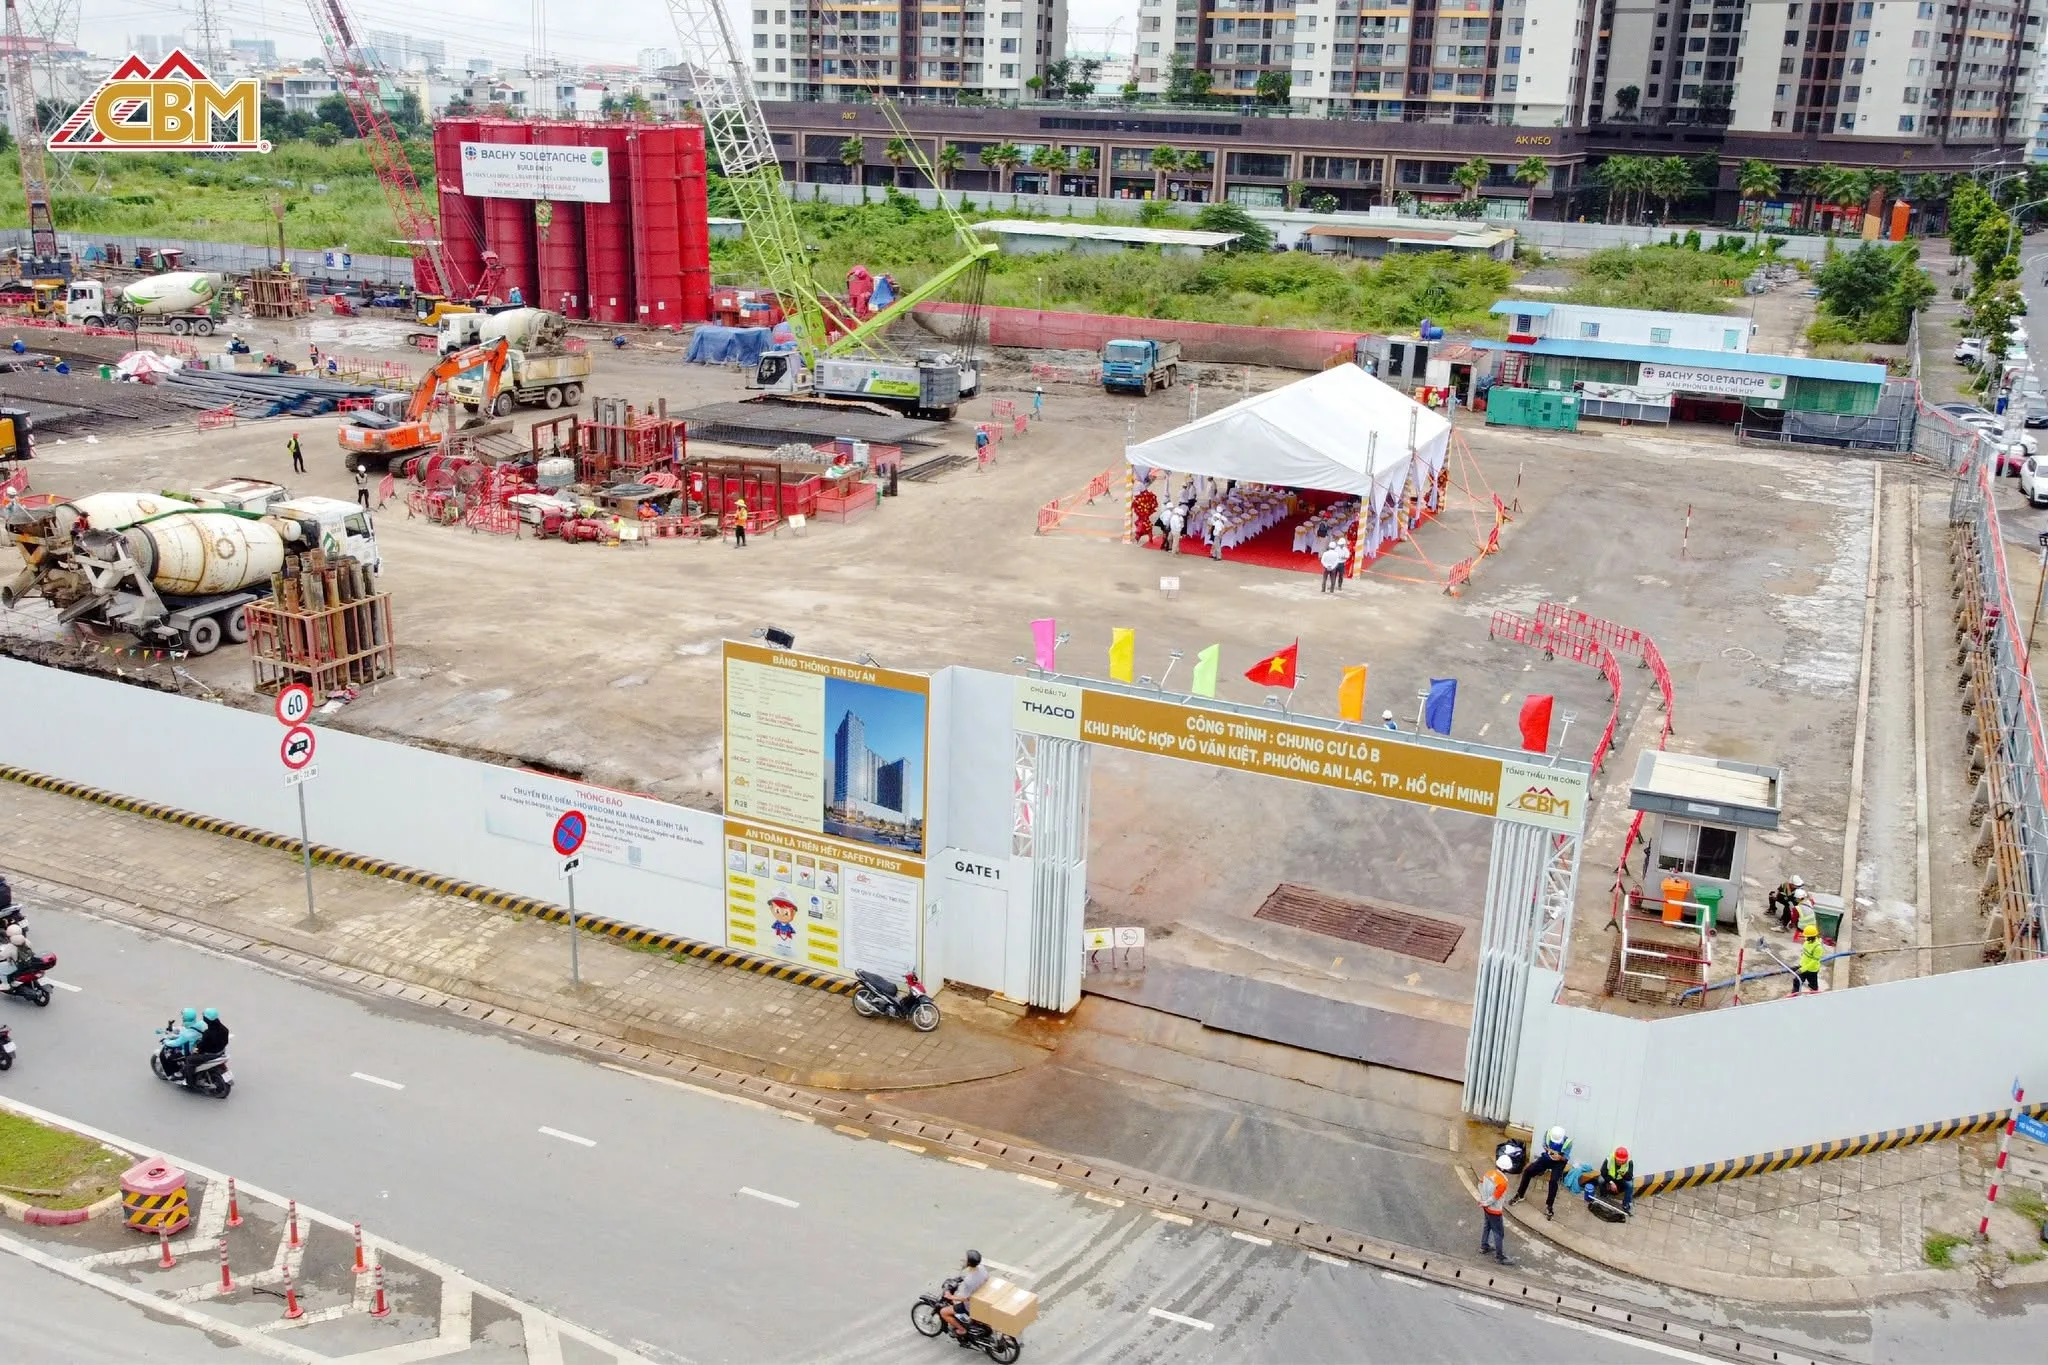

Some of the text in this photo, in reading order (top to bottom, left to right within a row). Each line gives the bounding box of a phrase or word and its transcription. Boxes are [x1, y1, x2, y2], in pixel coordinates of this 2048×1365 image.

[1515, 136, 1552, 145] AK NEO
[481, 150, 516, 160] BACHY
[1658, 370, 1693, 380] BACHY
[832, 666, 846, 676] TIN
[288, 694, 303, 715] 60
[1022, 700, 1075, 719] THACO
[1186, 714, 1224, 734] CÔNG
[1227, 722, 1267, 744] TRÌNH
[1277, 732, 1324, 753] CHUNG
[1327, 740, 1348, 757] CƯ
[1349, 743, 1368, 760] LÔ
[1371, 748, 1380, 763] B
[1084, 720, 1495, 806] KHU PHỨC HỢP VÕ VĂN KIỆT, PHƯỜNG AN LẠC, TP. HỒ CHÍ MINH
[1548, 774, 1558, 782] THI
[1560, 776, 1581, 786] CÔNG
[514, 786, 540, 800] CHUYỂN
[573, 800, 614, 816] SHOWROOM
[616, 810, 627, 819] KIA
[630, 813, 655, 825] MAZDA
[576, 790, 623, 808] THÔNG BÁO
[1519, 793, 1570, 817] CBM
[746, 828, 758, 838] AN
[759, 830, 782, 844] TOÀN
[785, 834, 796, 848] LÀ
[796, 838, 820, 852] TRÊN
[842, 850, 875, 866] SAFETY
[876, 858, 902, 871] FIRST
[955, 860, 1000, 880] GATE 1
